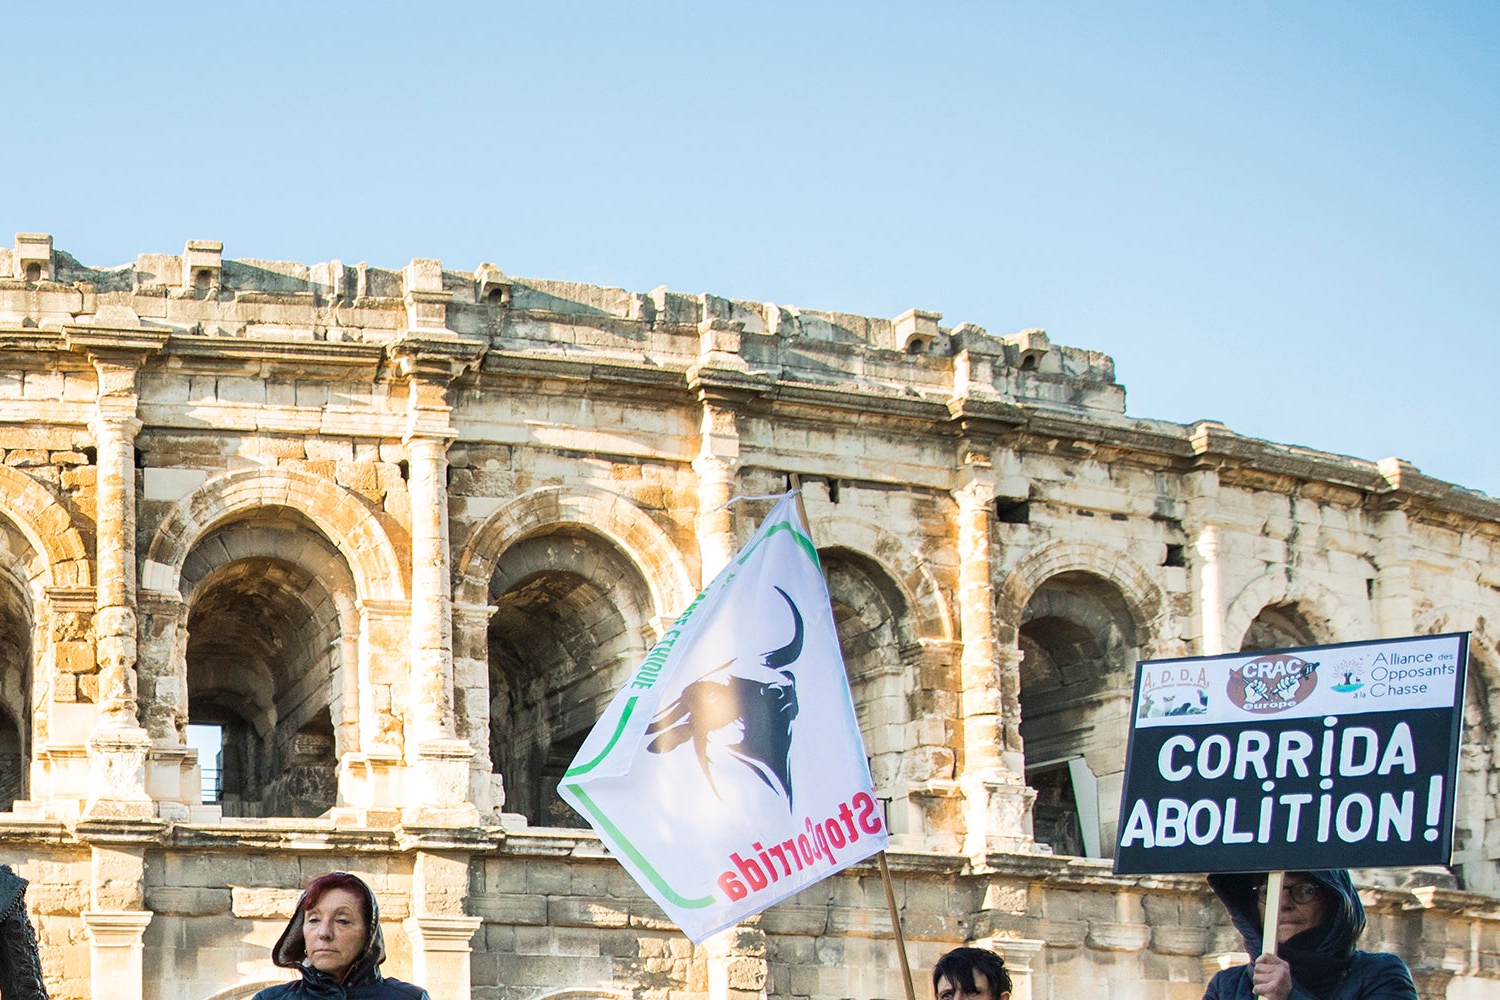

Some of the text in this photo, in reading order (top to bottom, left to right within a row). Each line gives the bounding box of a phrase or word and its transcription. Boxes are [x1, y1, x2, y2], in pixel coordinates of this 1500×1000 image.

[1372, 652, 1453, 667] Alliance des
[1242, 659, 1302, 679] CRAC
[1371, 663, 1455, 683] Opposants
[1370, 682, 1428, 698] Chasse
[1242, 700, 1297, 711] europe
